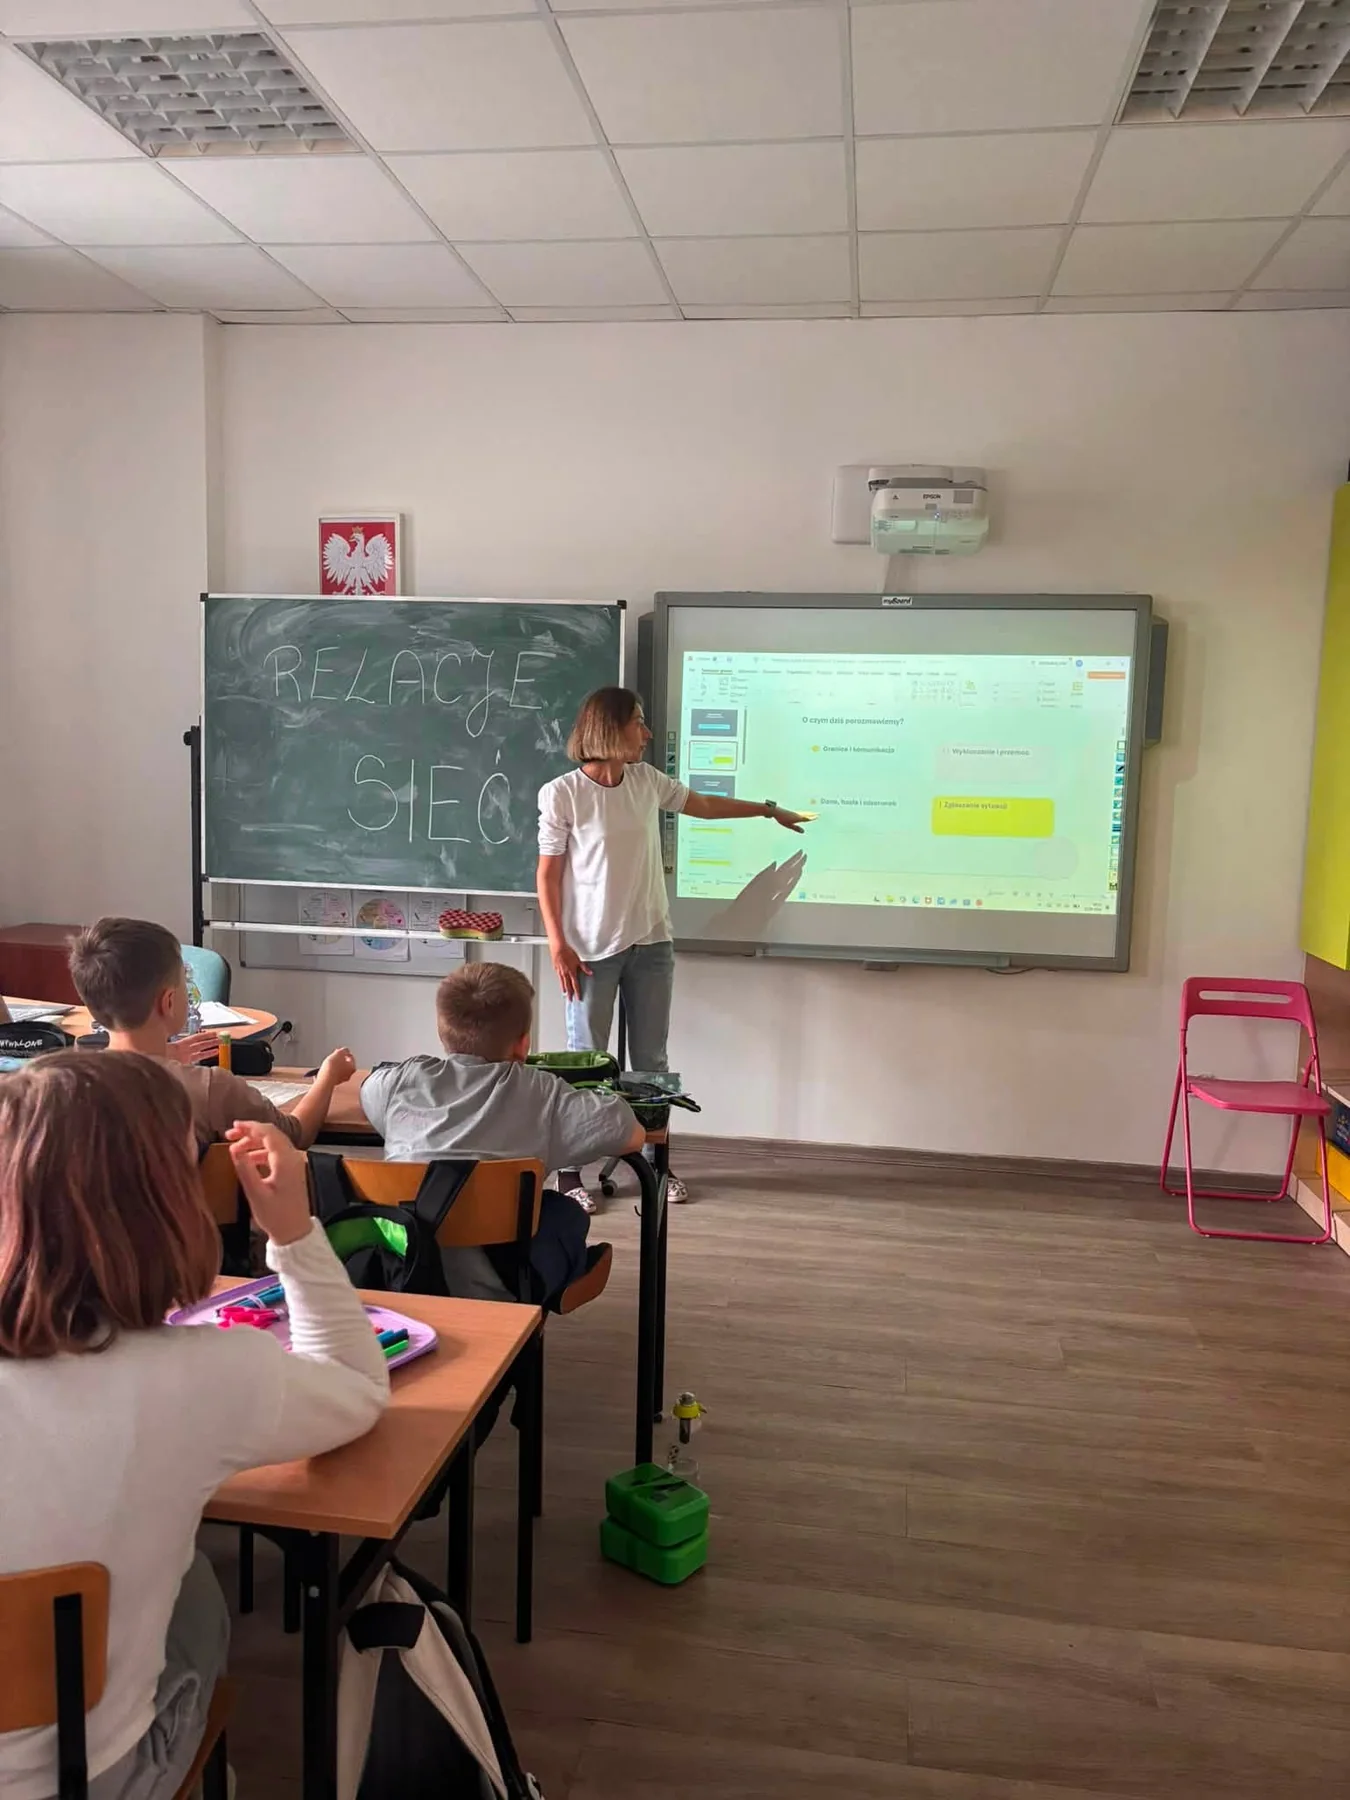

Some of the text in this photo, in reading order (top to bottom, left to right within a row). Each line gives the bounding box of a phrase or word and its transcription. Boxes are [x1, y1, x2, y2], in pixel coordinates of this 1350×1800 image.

[264, 645, 556, 737] RELACJE
[802, 716, 808, 724] O
[348, 749, 511, 845] SIEĆ
